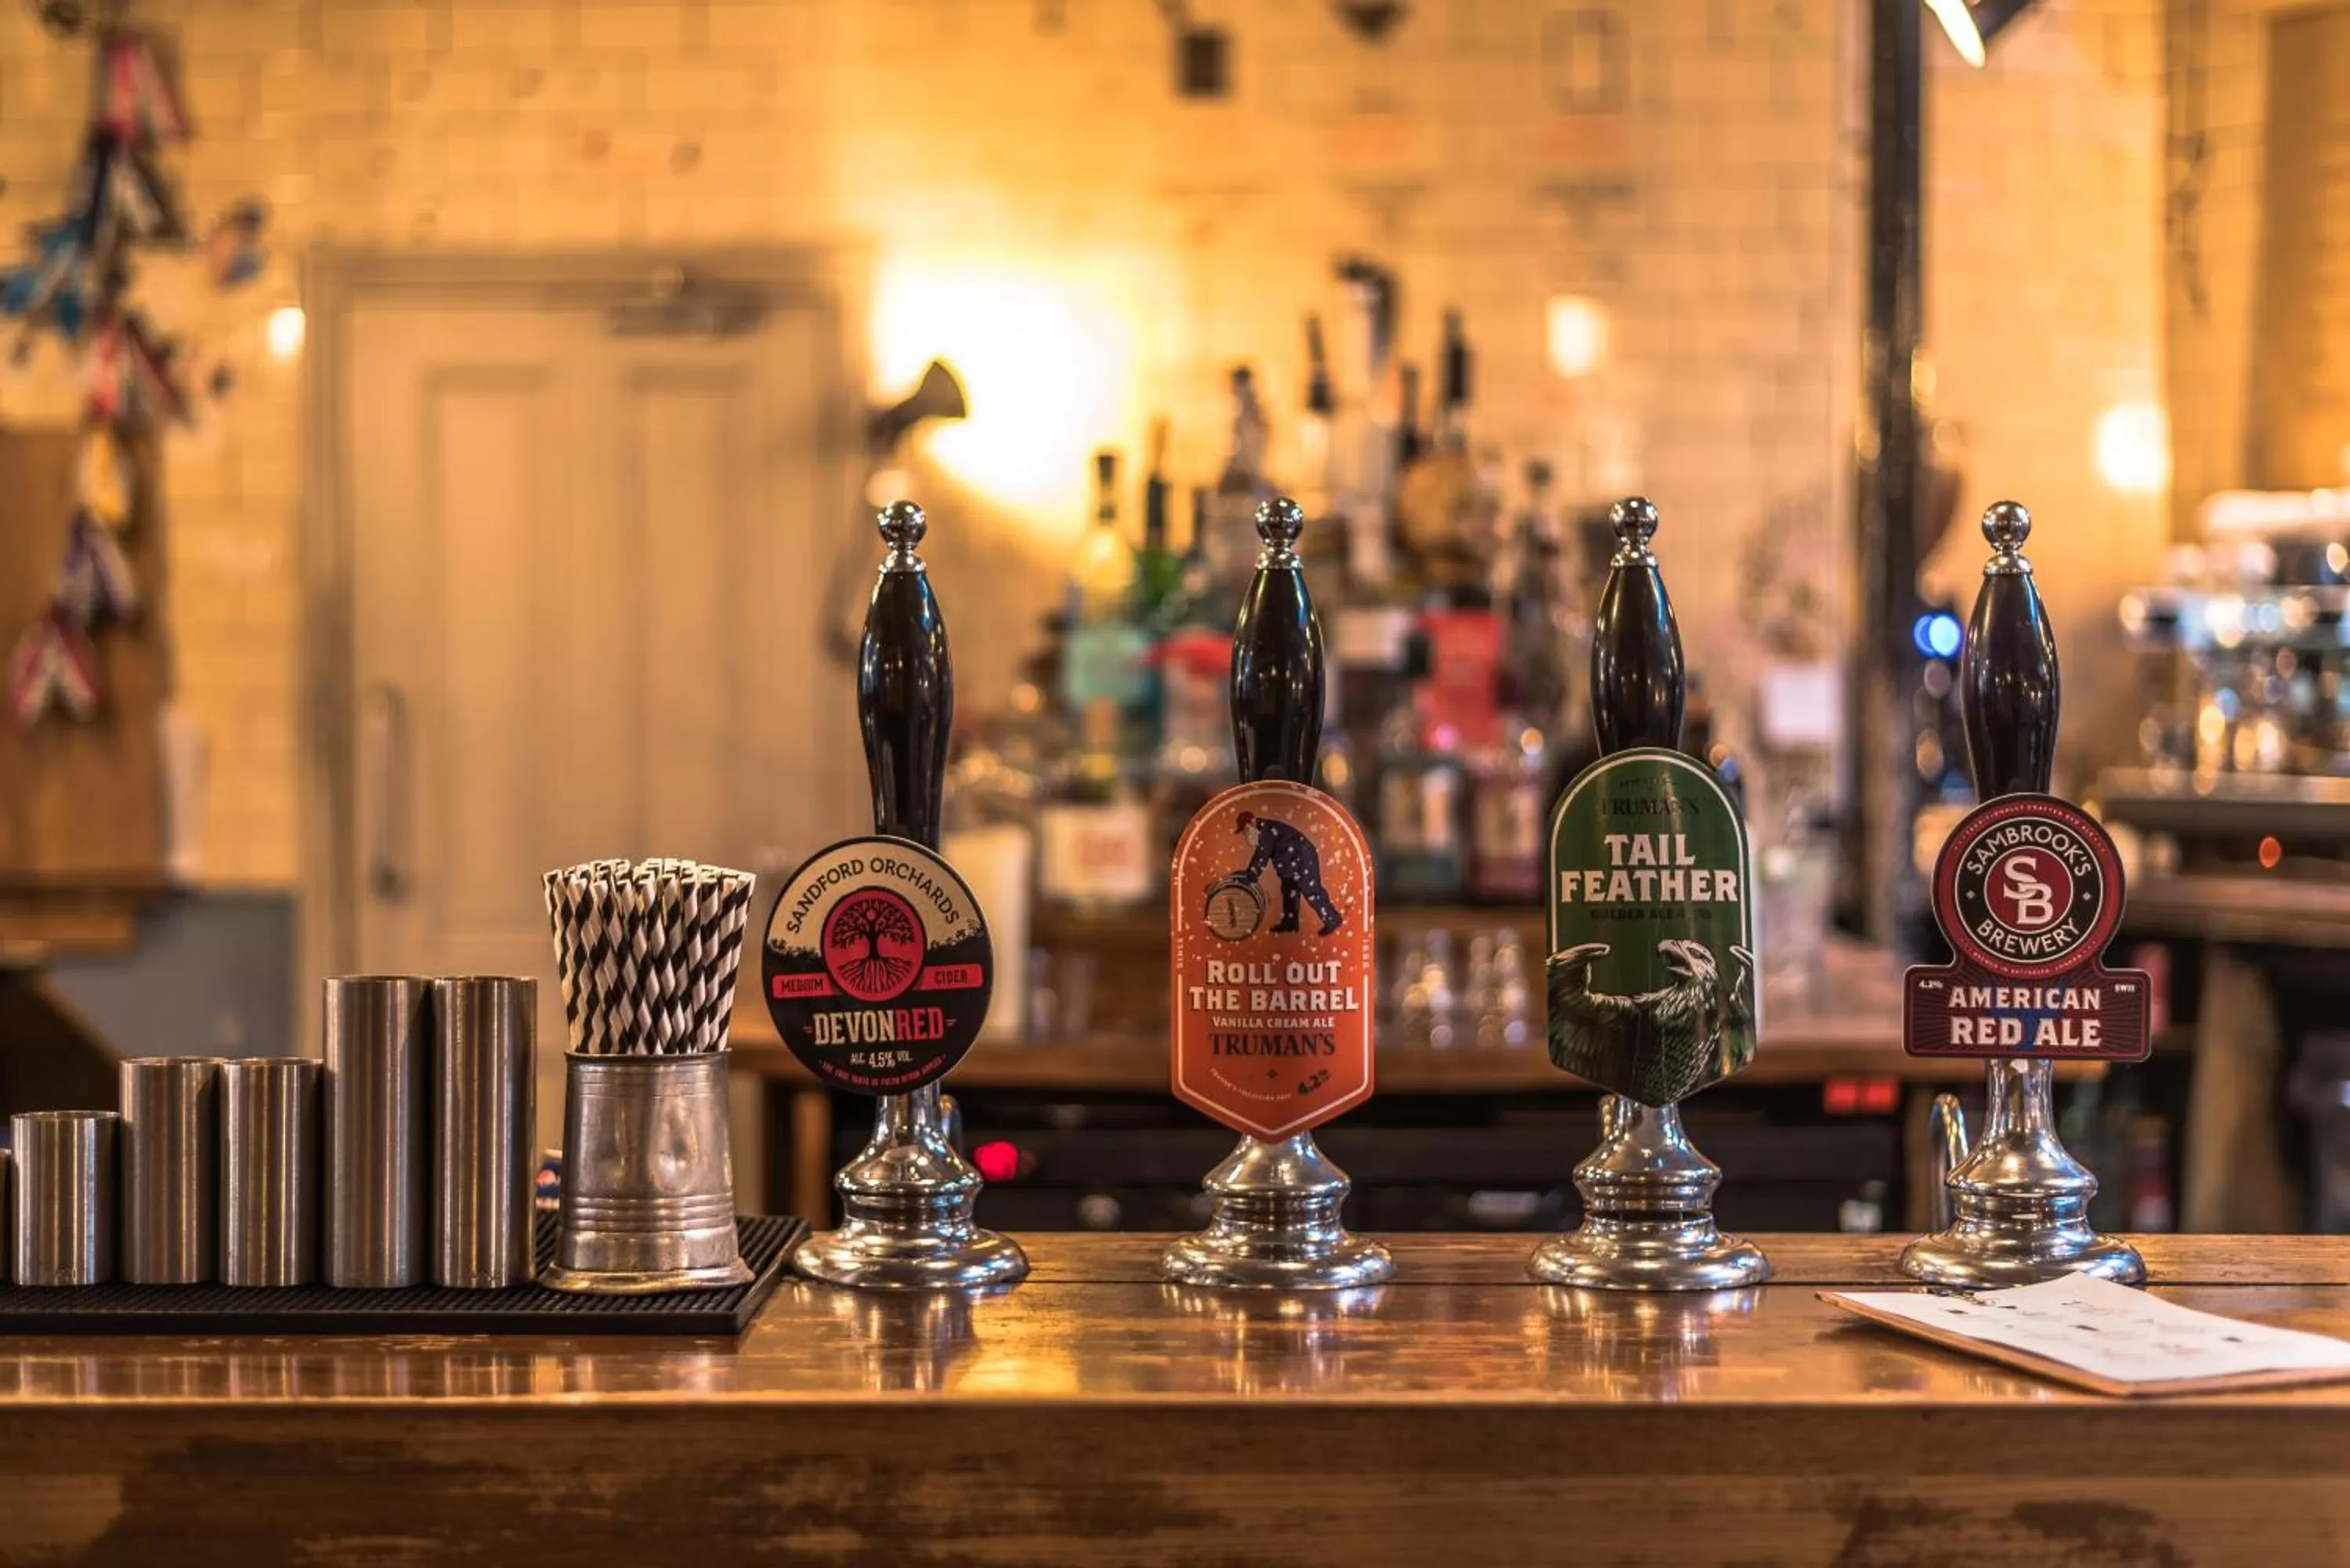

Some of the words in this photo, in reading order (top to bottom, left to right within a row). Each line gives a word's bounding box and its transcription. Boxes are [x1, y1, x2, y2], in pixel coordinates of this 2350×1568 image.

[1604, 833, 1696, 865] TAIL
[1968, 825, 2092, 876] SAMBROOK'S
[787, 859, 864, 934] SANDFORD
[870, 858, 960, 925] ORCHARDS
[1560, 869, 1738, 902] FEATHER
[1976, 918, 2080, 955] BREWERY
[781, 978, 824, 992] MEDIUM
[935, 970, 968, 985] CIDER
[1207, 960, 1278, 984] ROLL
[1285, 961, 1342, 984] OUT
[1189, 987, 1241, 1010] THE
[1251, 987, 1360, 1011] BARREL
[1949, 986, 2101, 1010] AMERICAN
[1212, 1017, 1264, 1028] VANILLA
[1267, 1017, 1309, 1028] CREAM
[1313, 1017, 1336, 1028] ALE
[1950, 1016, 2023, 1045] RED
[2034, 1017, 2102, 1047] ALE
[1208, 1032, 1336, 1057] TRUMAN'S
